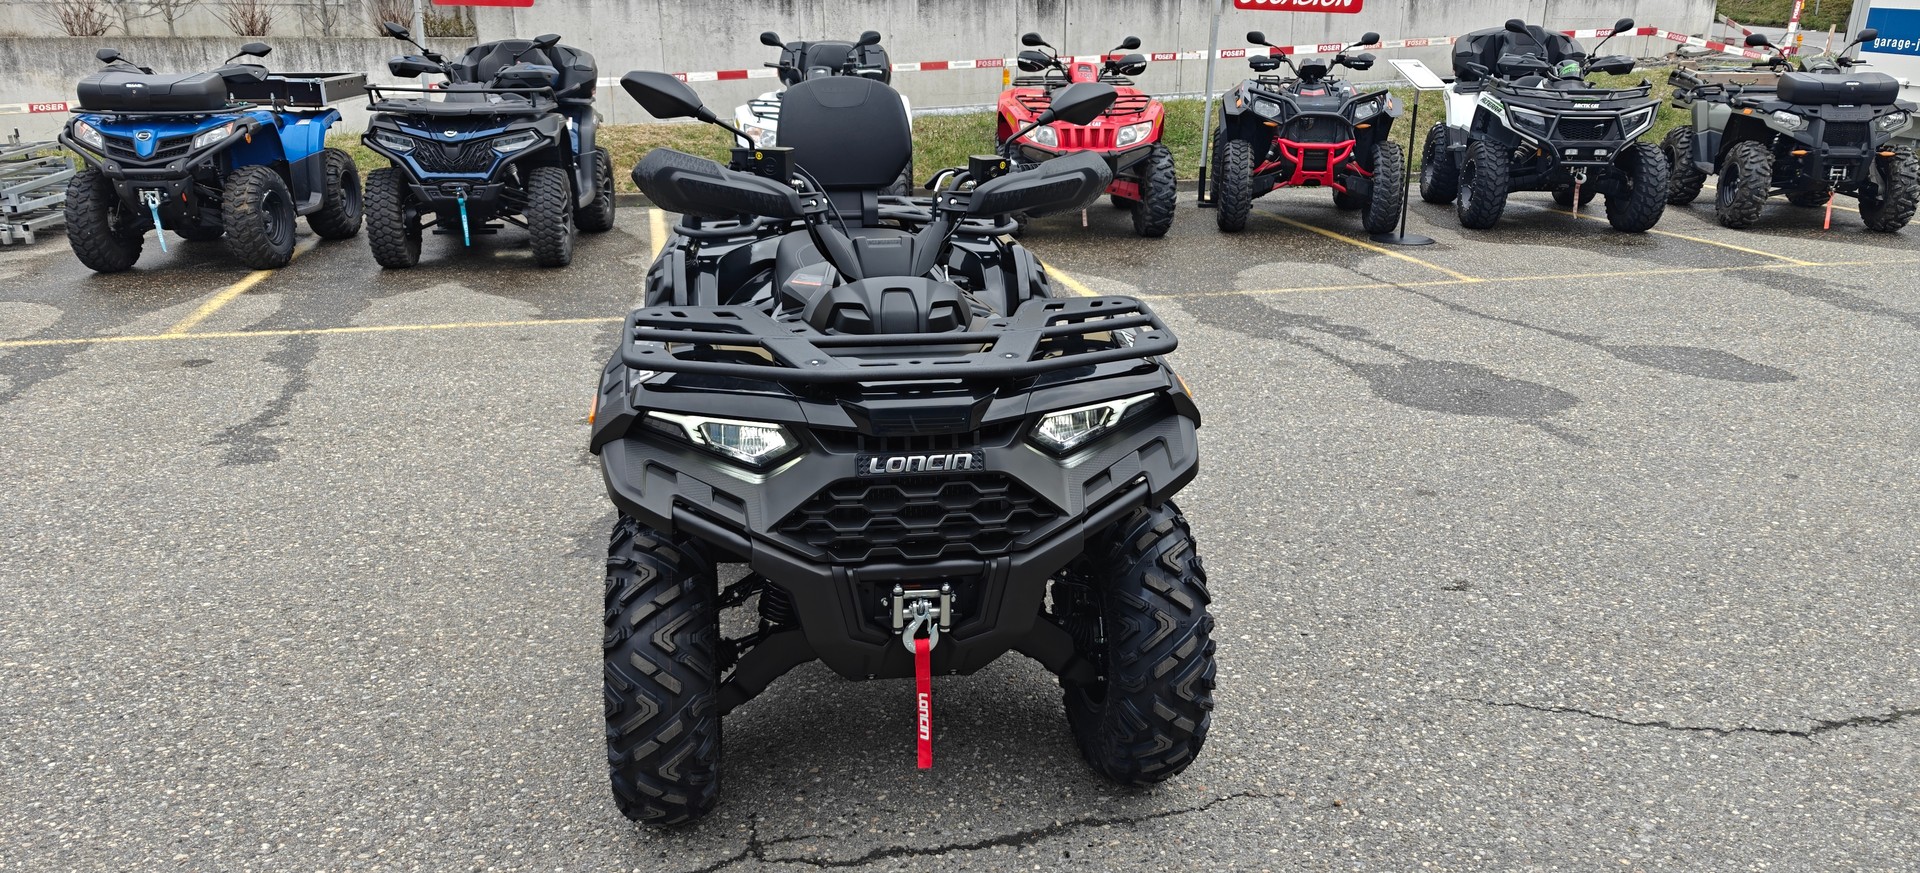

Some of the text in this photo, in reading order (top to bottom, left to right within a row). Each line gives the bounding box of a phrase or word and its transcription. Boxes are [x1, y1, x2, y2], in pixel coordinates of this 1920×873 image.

[32, 103, 64, 112] FOSER
[870, 454, 972, 473] LONCIN
[918, 692, 929, 740] LONCIN
